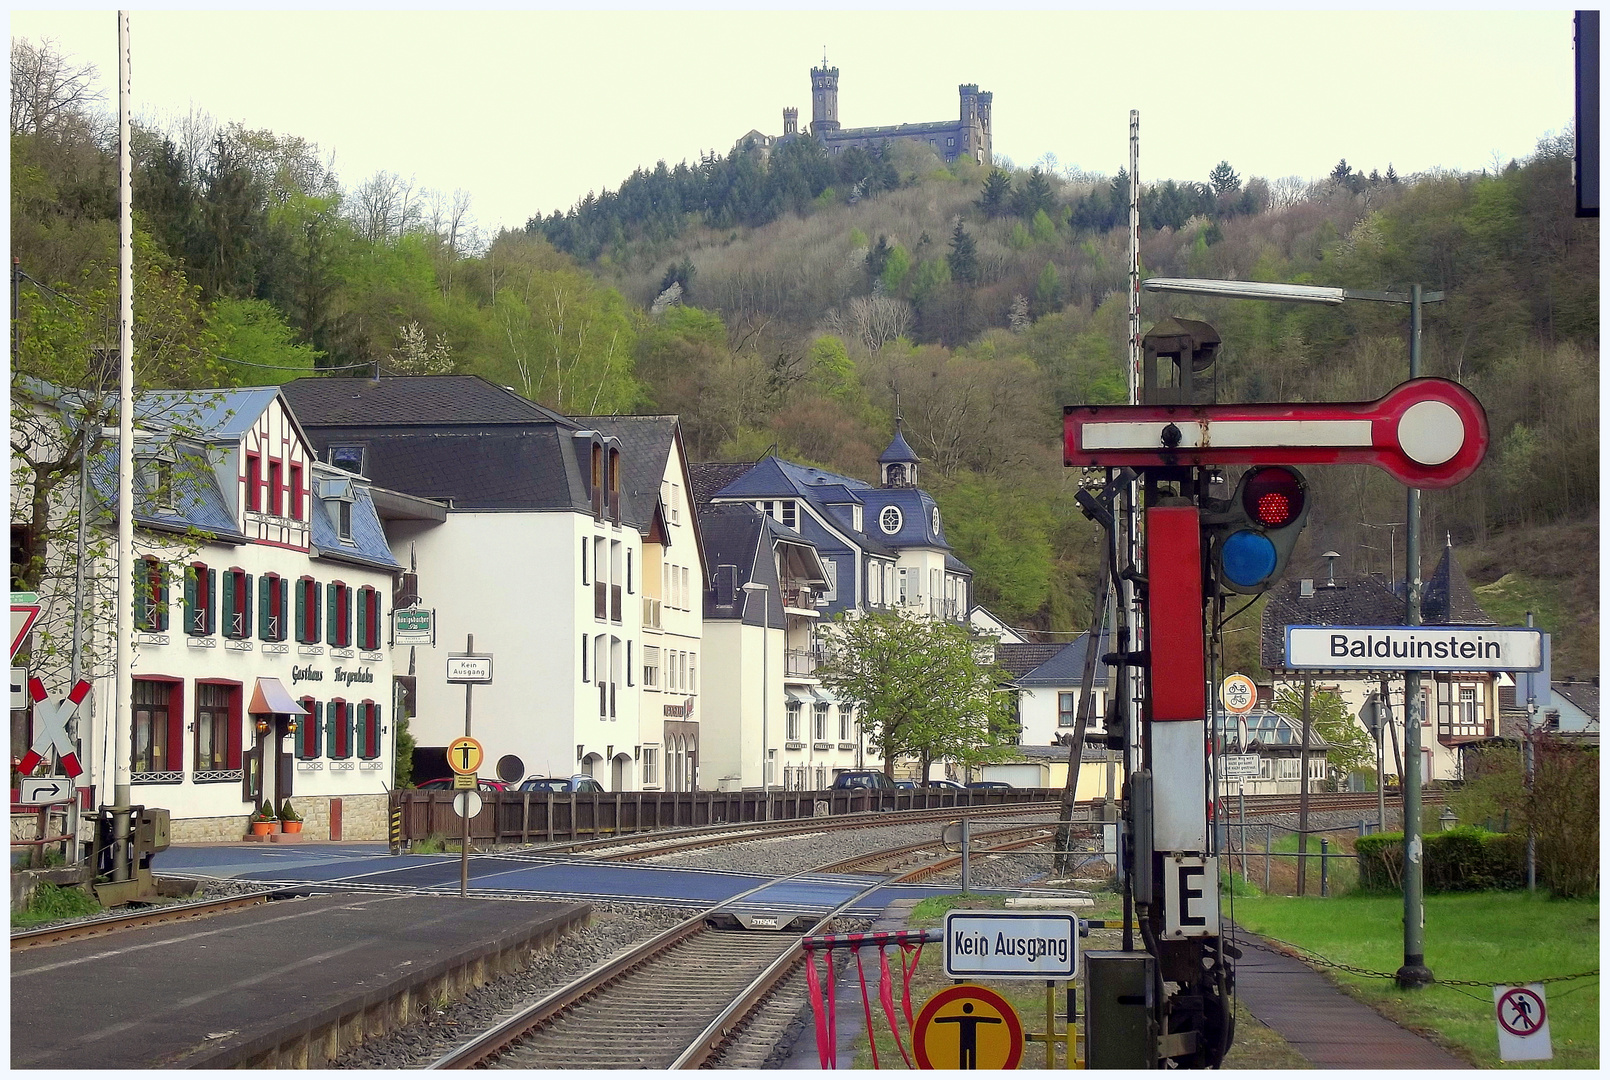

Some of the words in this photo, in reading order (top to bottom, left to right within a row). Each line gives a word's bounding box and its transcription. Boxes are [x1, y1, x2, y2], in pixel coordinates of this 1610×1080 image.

[1330, 634, 1501, 659] Balduinstein
[292, 664, 324, 686] Gasthaus
[1179, 867, 1206, 926] E
[955, 931, 989, 956] Kein
[994, 931, 1068, 963] Ausgang
